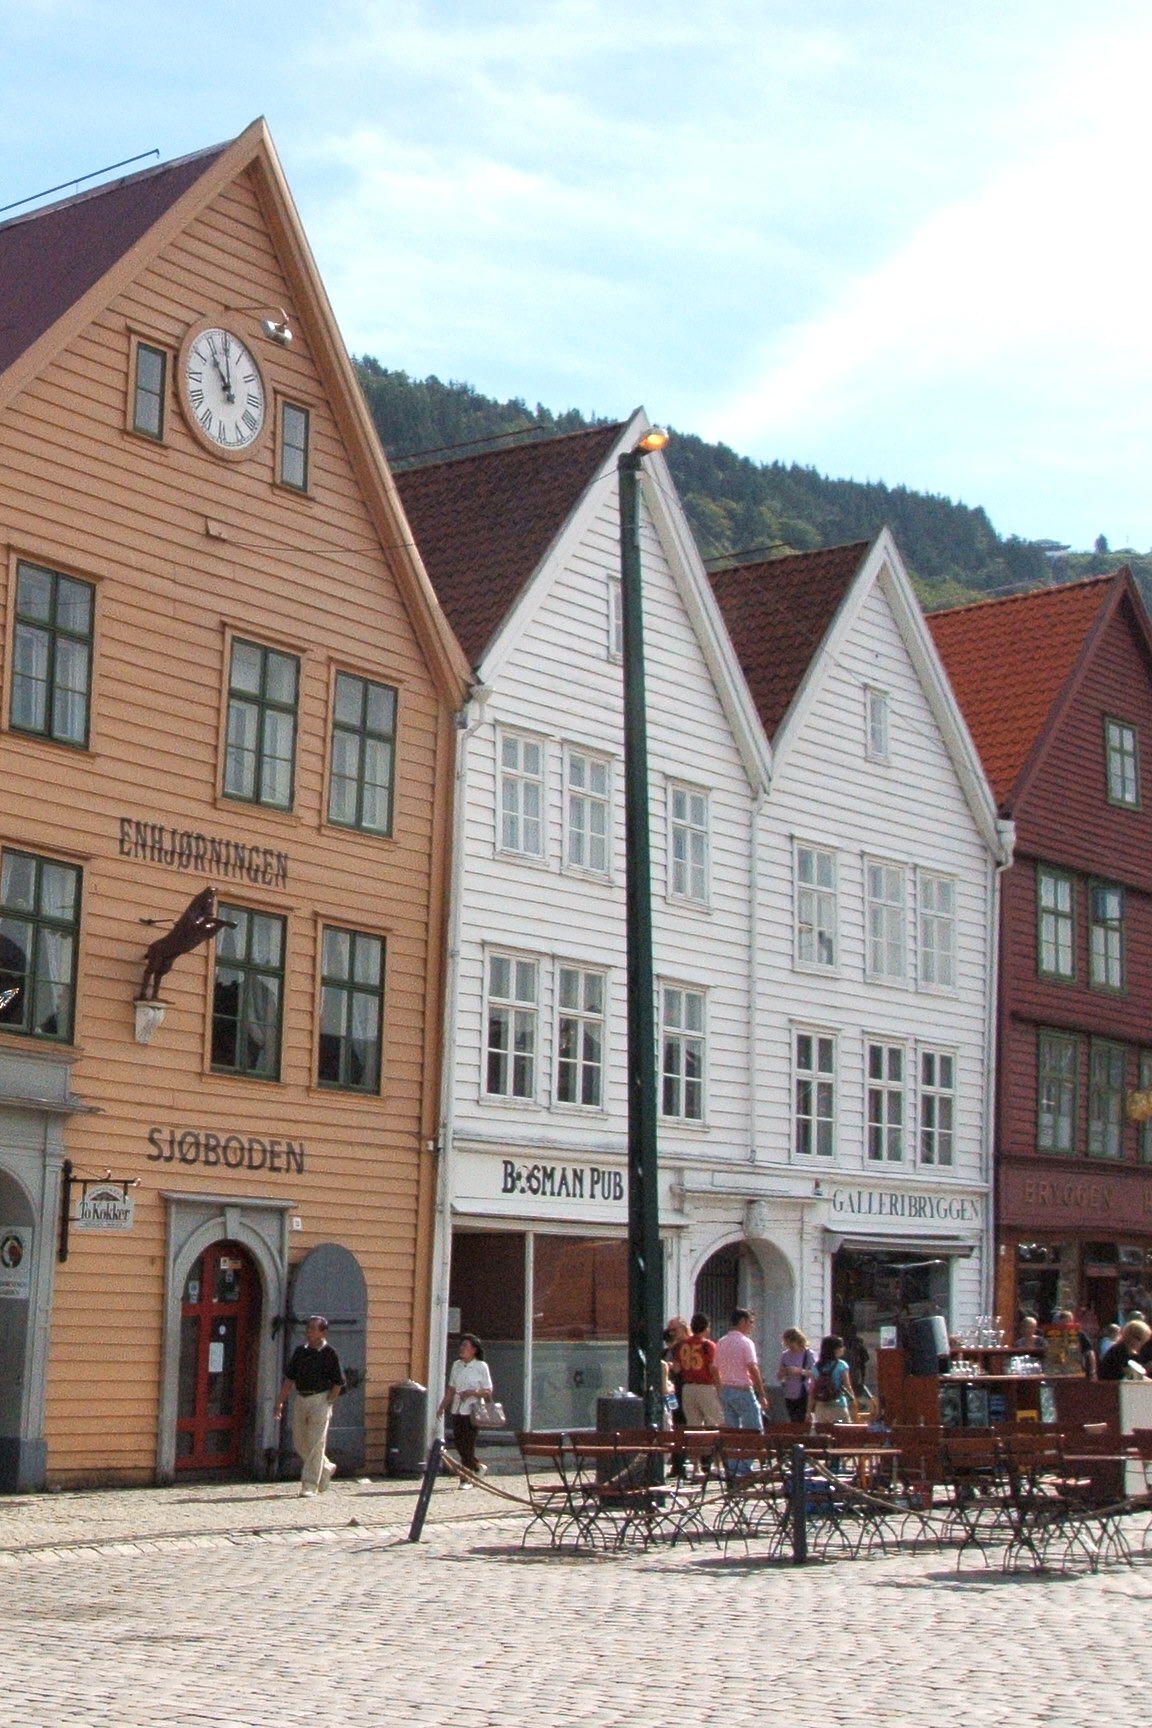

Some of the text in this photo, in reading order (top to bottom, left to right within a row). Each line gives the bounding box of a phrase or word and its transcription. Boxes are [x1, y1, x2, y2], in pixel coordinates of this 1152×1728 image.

[119, 817, 288, 889] ENHJØRNINGEN
[146, 1127, 305, 1174] SJØBODEN
[589, 1167, 624, 1200] PUB
[79, 1201, 130, 1220] To Kokker
[833, 1189, 980, 1221] GALLERI BRYGGEN
